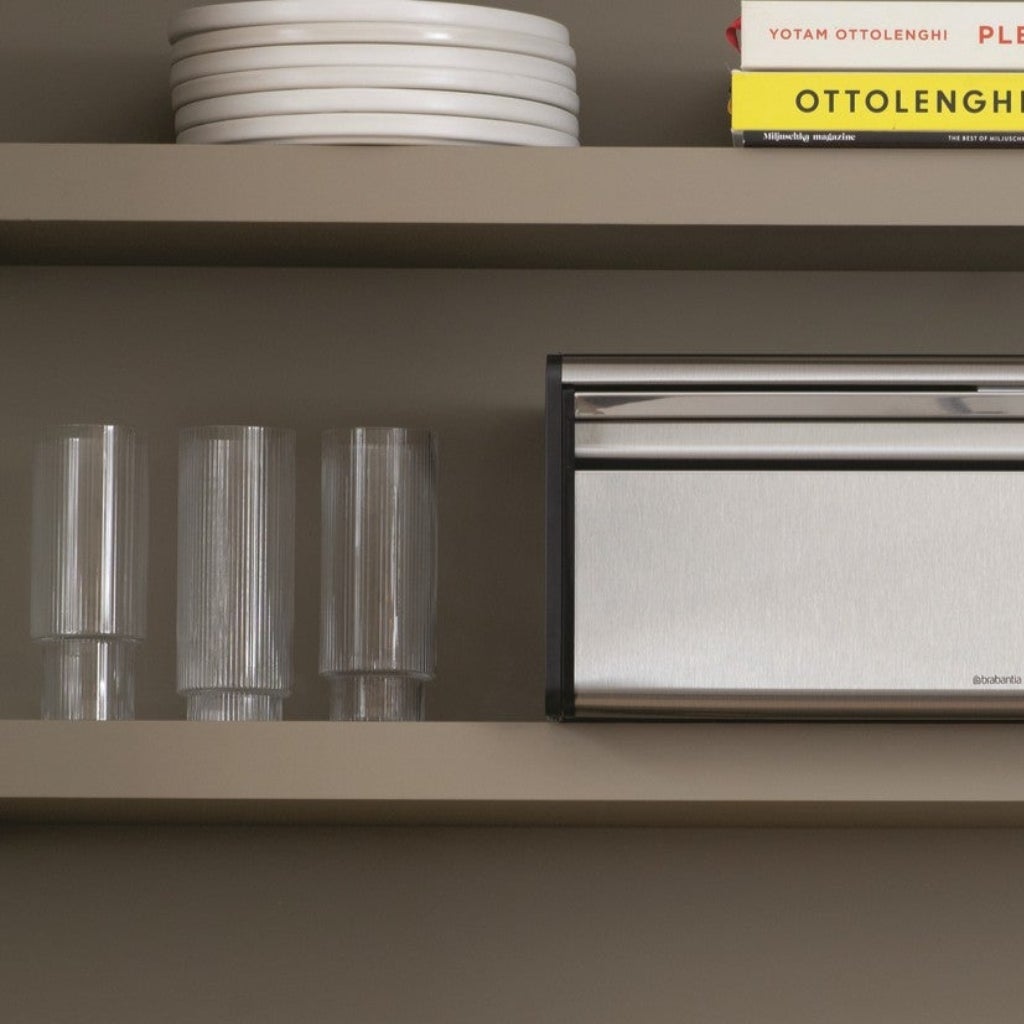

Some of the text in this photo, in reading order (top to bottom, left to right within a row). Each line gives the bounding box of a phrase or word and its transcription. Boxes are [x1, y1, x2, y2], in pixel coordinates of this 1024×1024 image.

[770, 28, 948, 41] YOTAM OTTOLENGHI
[812, 132, 856, 142] magazine
